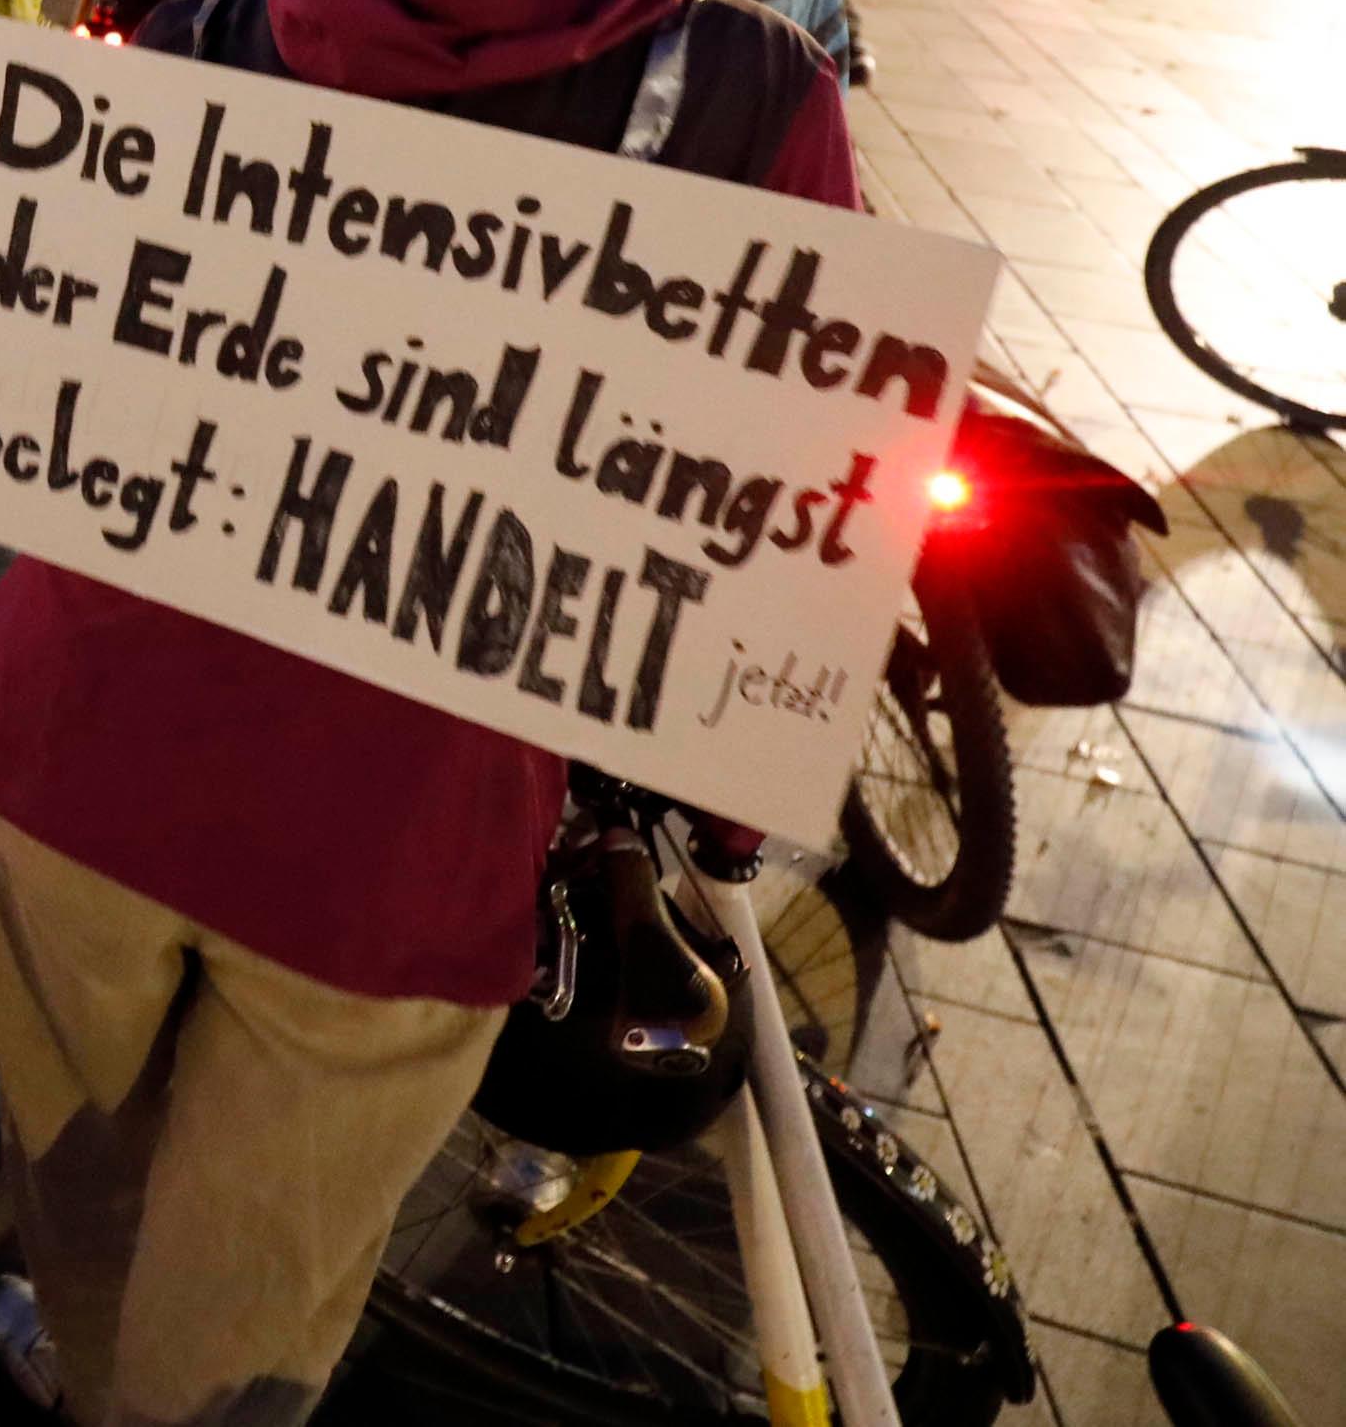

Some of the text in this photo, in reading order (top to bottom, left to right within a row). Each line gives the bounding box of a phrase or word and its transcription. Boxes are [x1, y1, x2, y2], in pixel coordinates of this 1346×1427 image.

[112, 237, 305, 390] Erde
[335, 336, 542, 452] sind
[554, 367, 879, 567] längst
[183, 98, 949, 421] Intensivbetten
[254, 435, 711, 734] HANDELT
